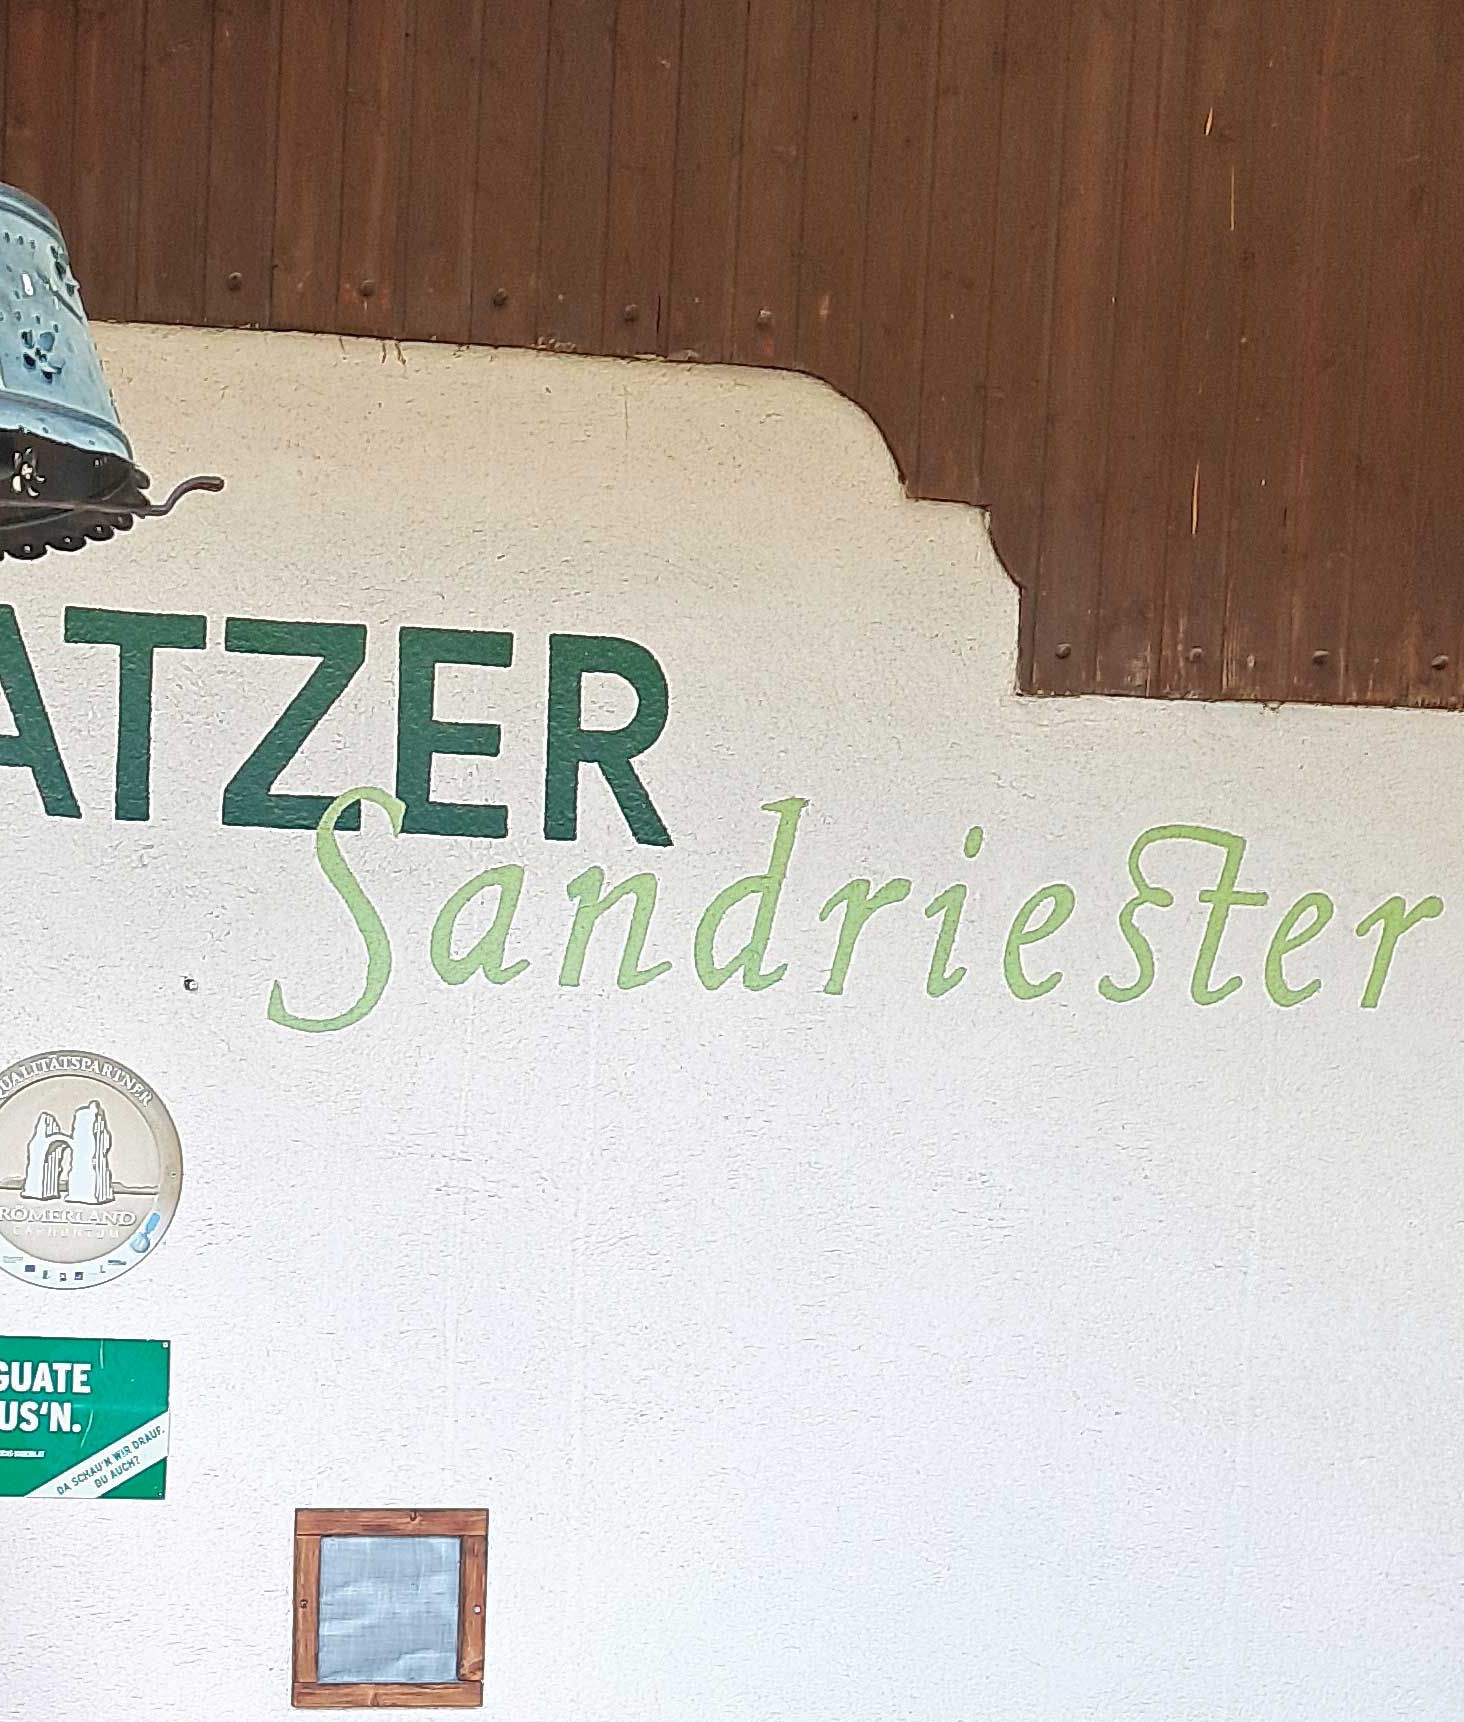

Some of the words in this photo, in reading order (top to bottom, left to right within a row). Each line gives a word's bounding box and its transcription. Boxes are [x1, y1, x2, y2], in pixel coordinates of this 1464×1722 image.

[267, 787, 1445, 1034] Sandriester
[56, 1482, 72, 1495] DA
[111, 1445, 133, 1461] WIR
[94, 1474, 109, 1489] DU
